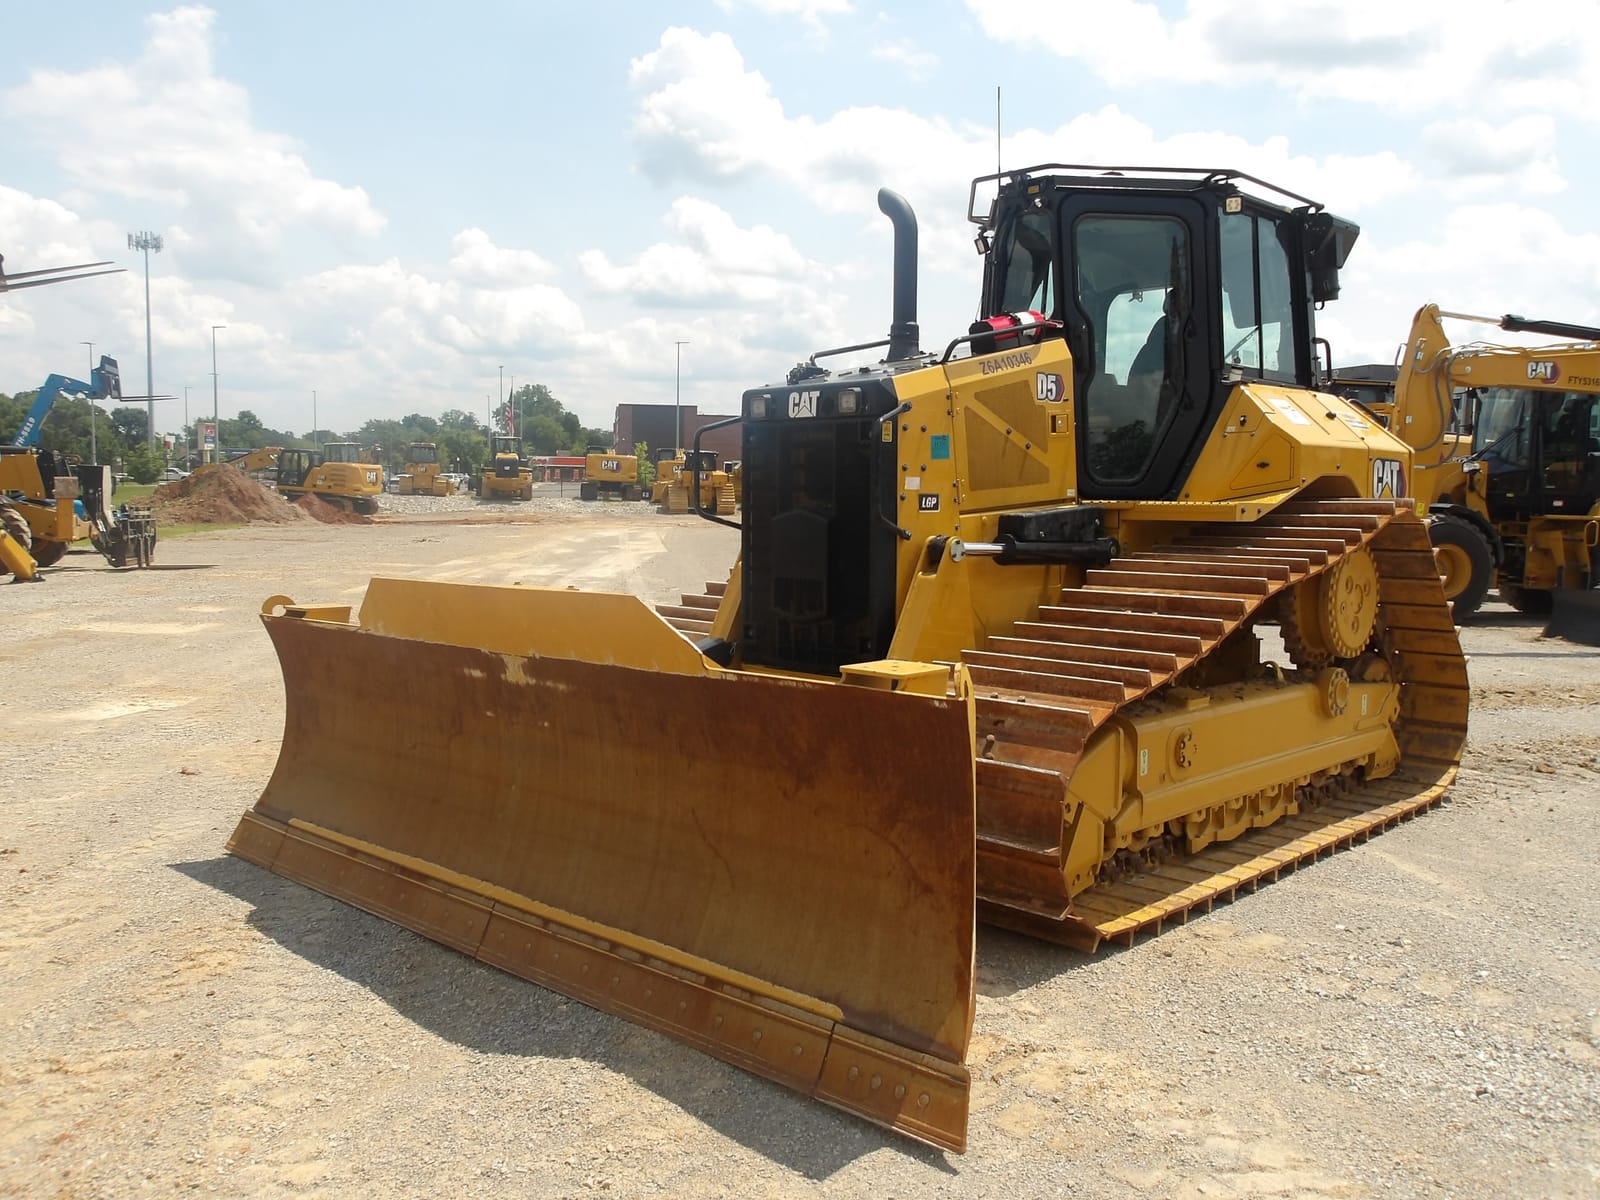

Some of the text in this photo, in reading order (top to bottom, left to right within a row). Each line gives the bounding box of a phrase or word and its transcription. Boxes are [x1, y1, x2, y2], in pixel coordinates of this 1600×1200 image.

[979, 352, 1033, 375] Z6A10346
[1527, 361, 1553, 379] CAT
[1037, 373, 1057, 400] D5
[788, 390, 820, 418] CAT
[601, 461, 618, 471] CAT
[366, 471, 376, 482] CAT
[1373, 459, 1400, 499] CAT
[922, 497, 937, 508] LGP
